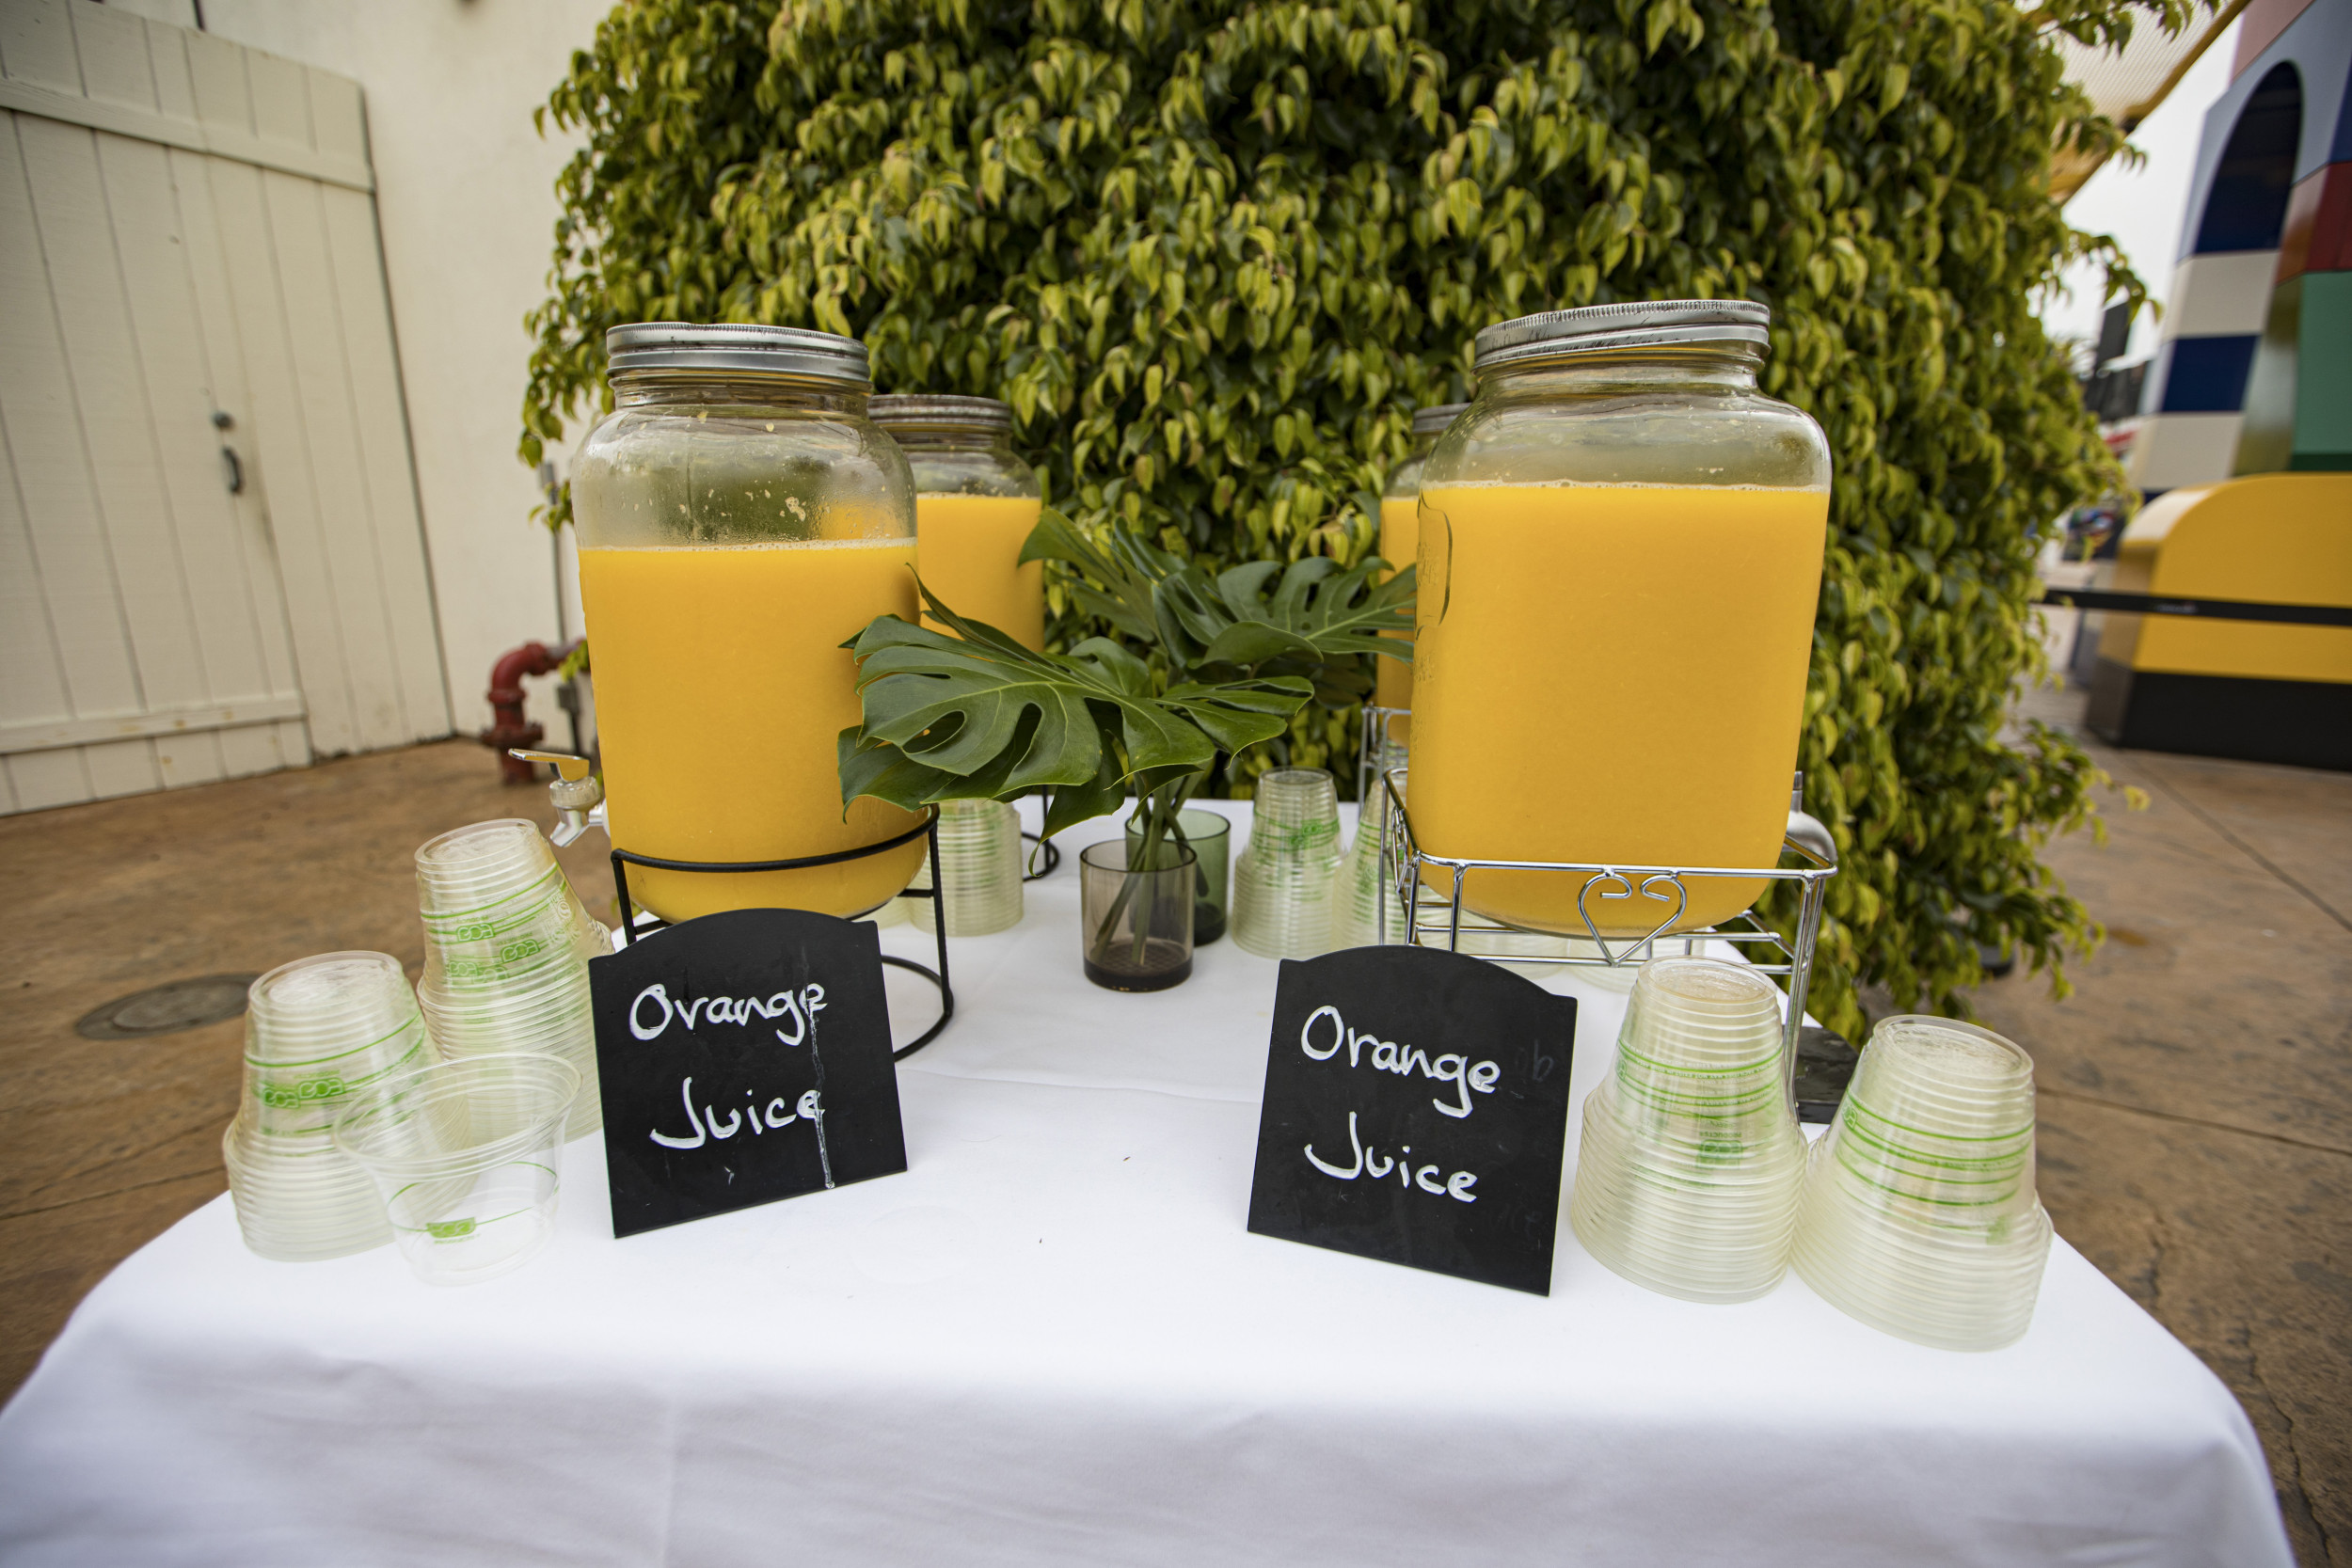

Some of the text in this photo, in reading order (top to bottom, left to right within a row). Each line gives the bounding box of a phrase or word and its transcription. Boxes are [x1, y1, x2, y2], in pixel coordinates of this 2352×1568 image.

[629, 983, 827, 1046] Orange
[1300, 1005, 1501, 1118] Orange
[649, 1076, 825, 1149] Juice
[1304, 1111, 1478, 1202] Juice
